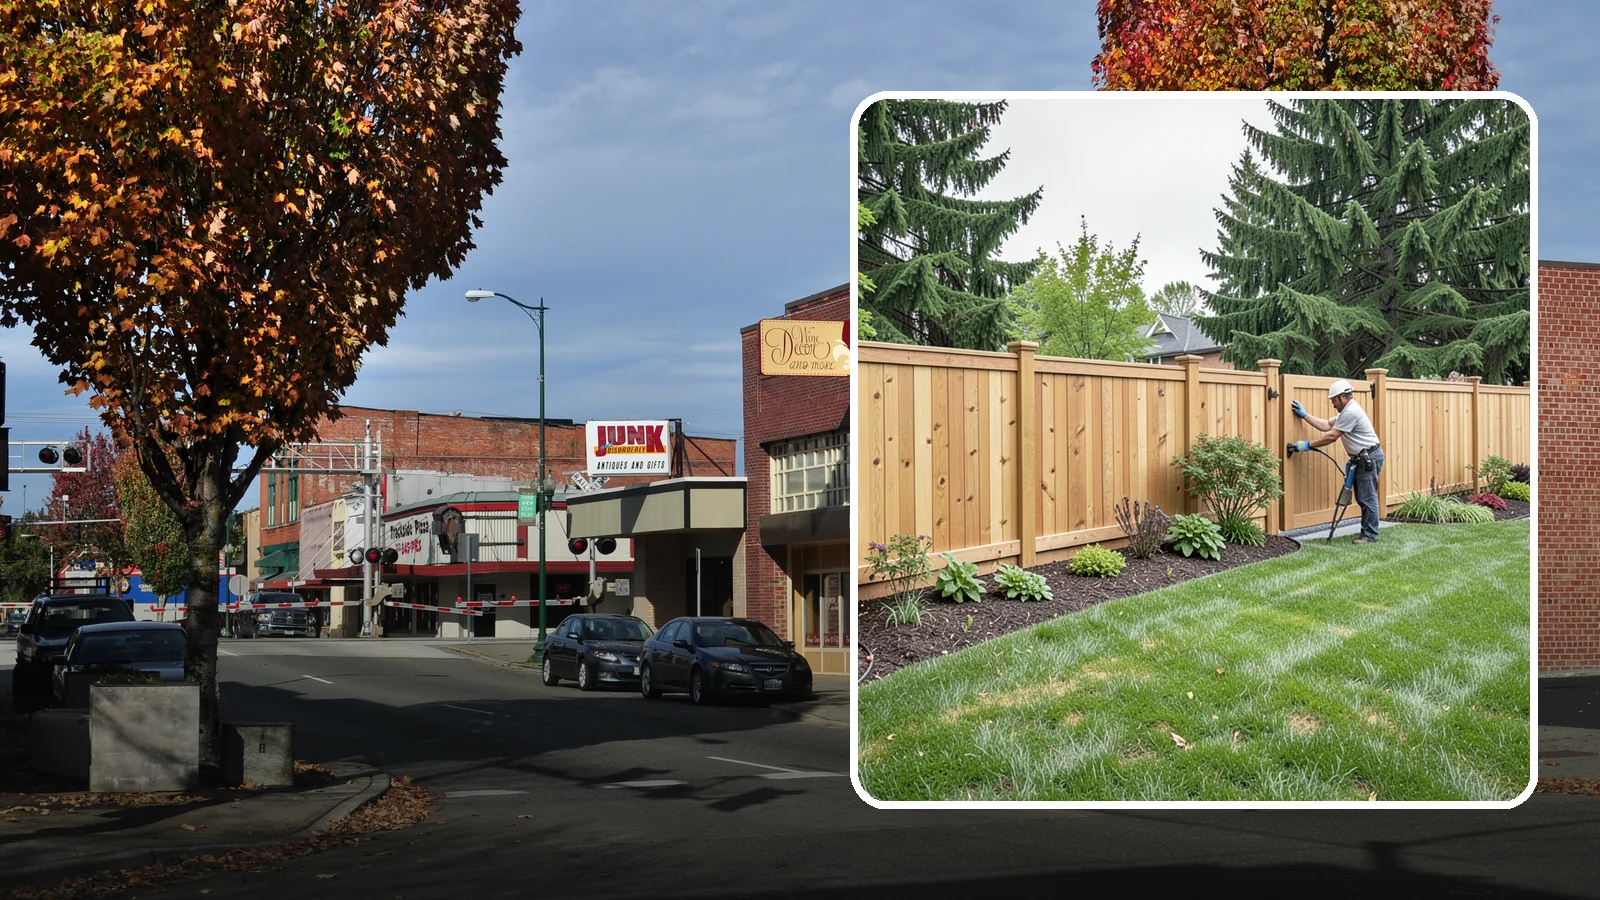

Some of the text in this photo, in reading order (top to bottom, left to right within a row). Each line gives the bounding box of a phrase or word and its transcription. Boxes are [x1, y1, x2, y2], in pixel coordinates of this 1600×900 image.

[596, 425, 665, 457] JUNK
[607, 446, 645, 454] DISORDERLY
[597, 460, 666, 470] ANTIQUES AND GIFTS
[390, 519, 429, 540] Trackside Pizza
